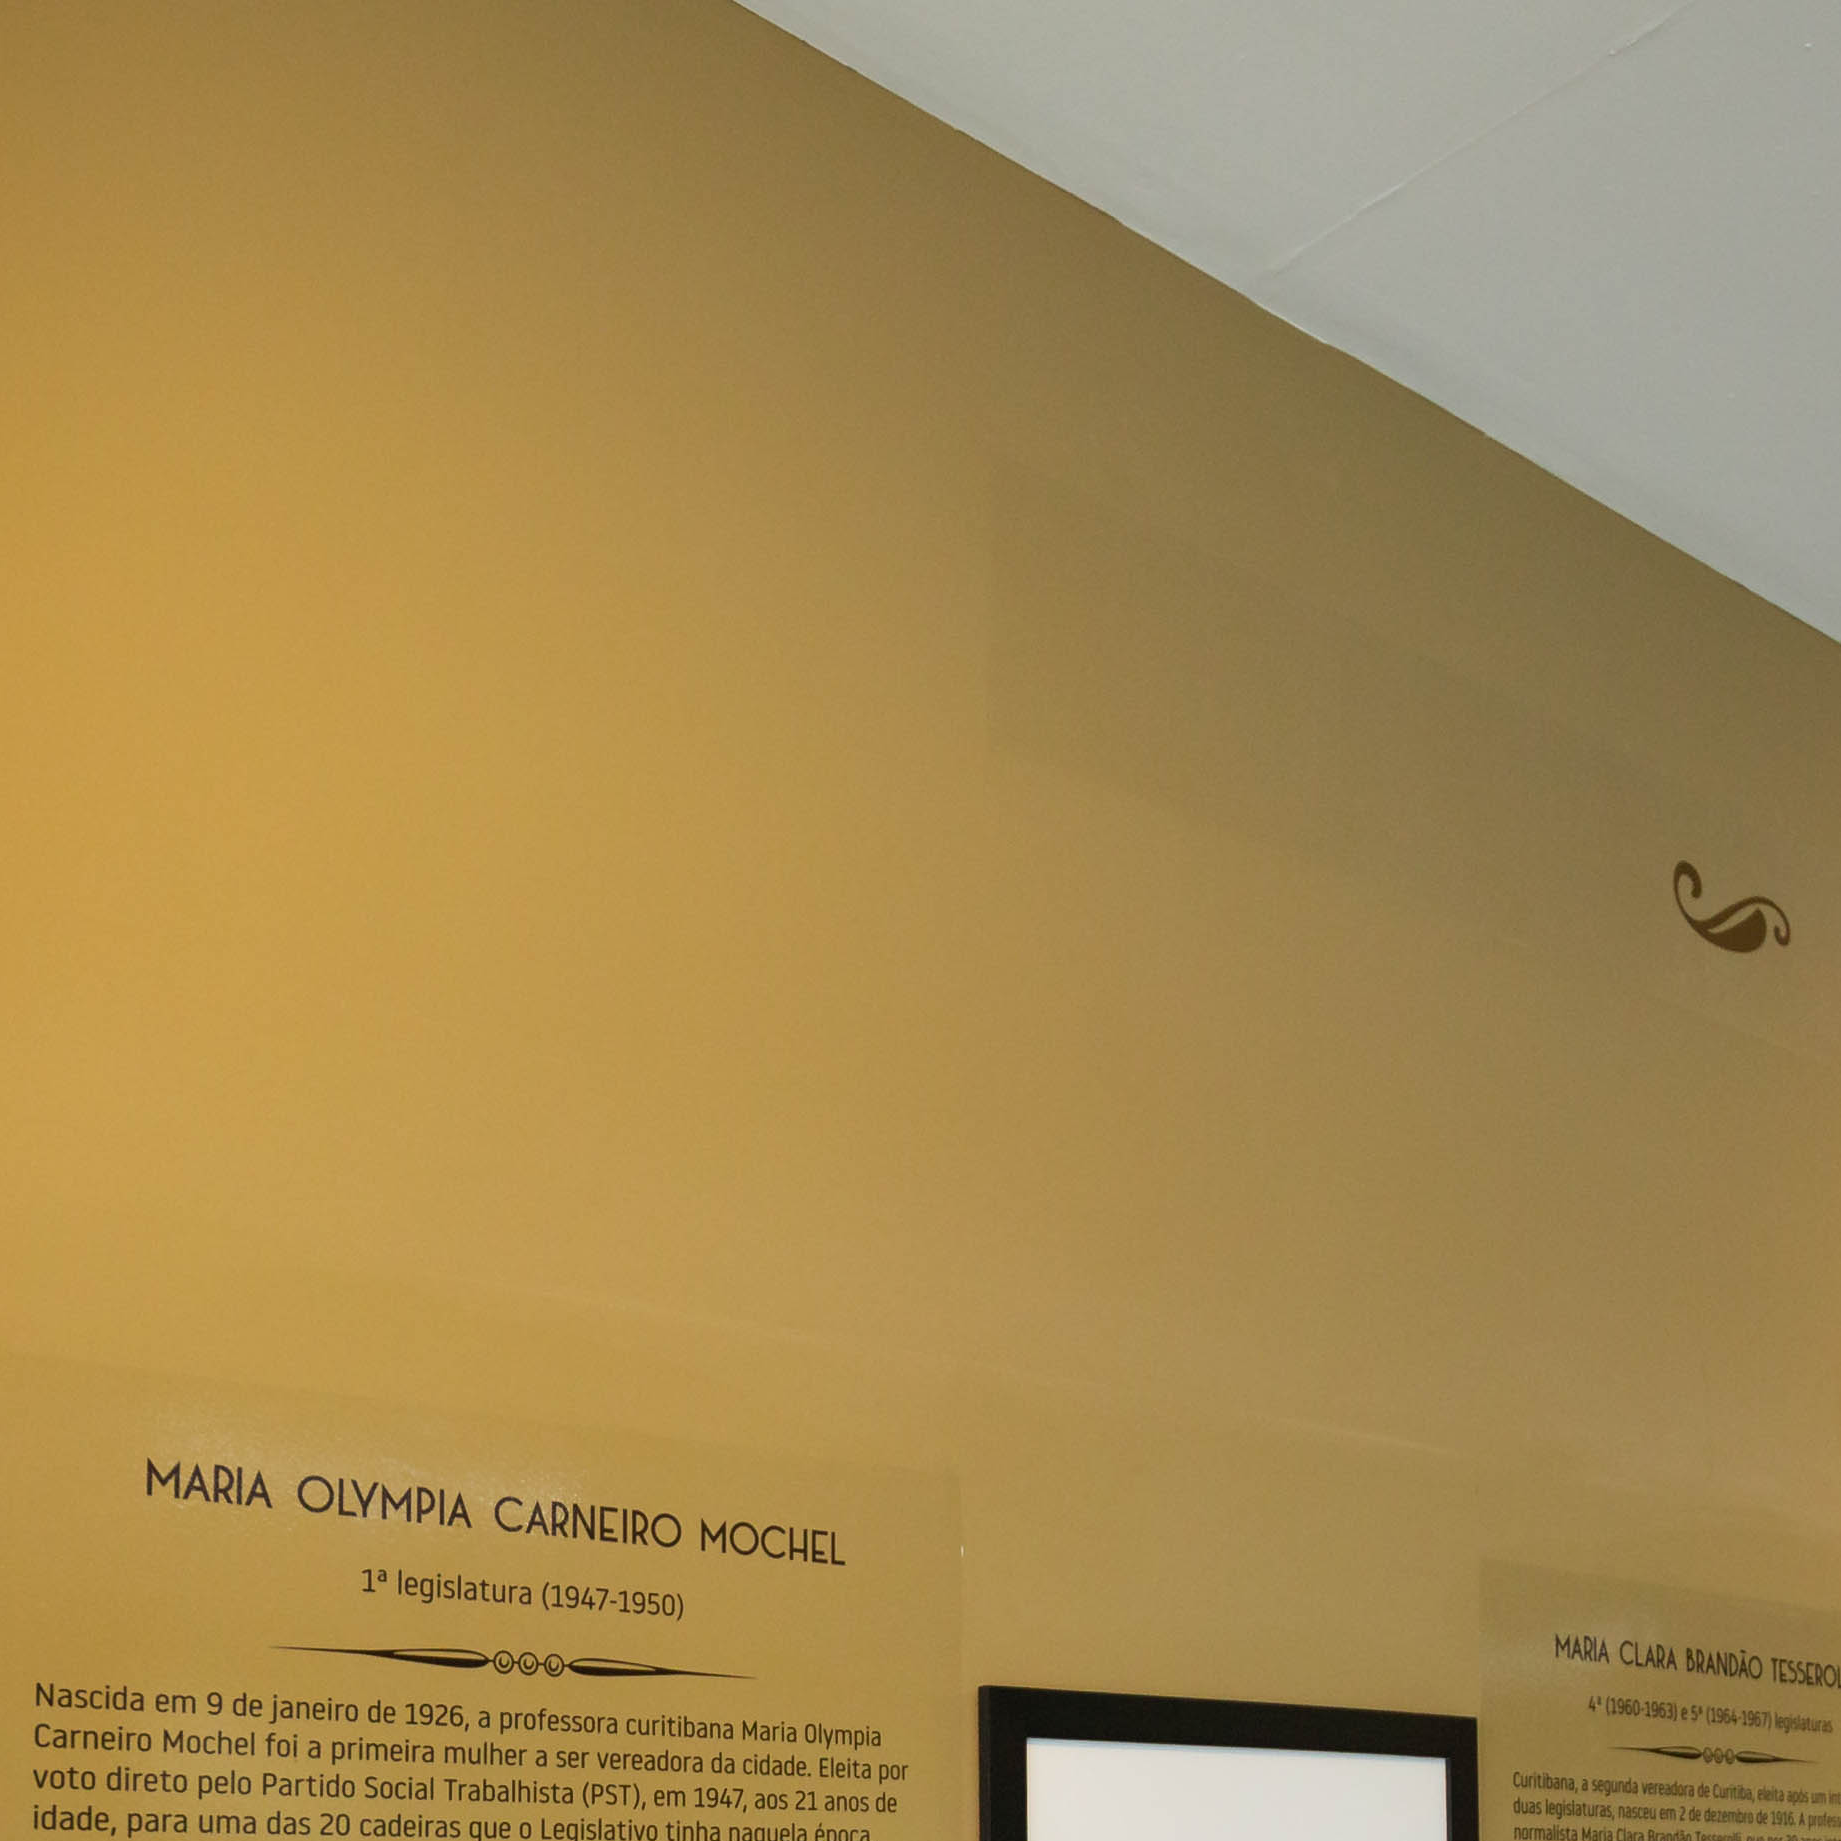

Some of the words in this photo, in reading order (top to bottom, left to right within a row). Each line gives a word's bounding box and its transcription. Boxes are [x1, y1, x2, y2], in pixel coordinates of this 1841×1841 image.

[146, 1457, 273, 1509] MARIA
[297, 1475, 473, 1529] OLYMPIA
[494, 1496, 682, 1548] CARNEIRO
[700, 1518, 846, 1566] MOCHEL
[398, 1568, 532, 1606] legislatura
[541, 1581, 684, 1622] (1947-1950)
[1554, 1633, 1610, 1664] MARIA
[1619, 1640, 1678, 1672] CLARA
[1685, 1647, 1763, 1681] BRANDÃO
[35, 1682, 145, 1712] Nascida
[155, 1693, 196, 1714] em
[207, 1692, 223, 1716] 9
[232, 1692, 263, 1718] de
[268, 1694, 359, 1725] janeiro
[367, 1699, 396, 1724] de
[405, 1703, 469, 1732] 1926,
[478, 1710, 491, 1728] a
[500, 1708, 618, 1735] professora
[626, 1714, 734, 1740] curitibana
[742, 1720, 797, 1744] Maria
[804, 1722, 881, 1751] Olympia
[1605, 1696, 1678, 1722] (1960-1963)
[1680, 1706, 1689, 1722] e
[1706, 1706, 1772, 1732] (1964-1967)
[1774, 1712, 1833, 1736] legislaturas
[34, 1723, 152, 1752] Carneiro
[163, 1728, 255, 1756] Mochel
[265, 1732, 298, 1762] foi
[307, 1740, 321, 1759] a
[331, 1737, 435, 1766] primeira
[444, 1741, 528, 1766] mulher
[535, 1749, 547, 1768] a
[555, 1750, 590, 1769] ser
[597, 1749, 703, 1773] vereadora
[711, 1752, 735, 1774] da
[743, 1753, 812, 1778] cidade.
[819, 1756, 871, 1780] Eleita
[879, 1764, 909, 1786] por
